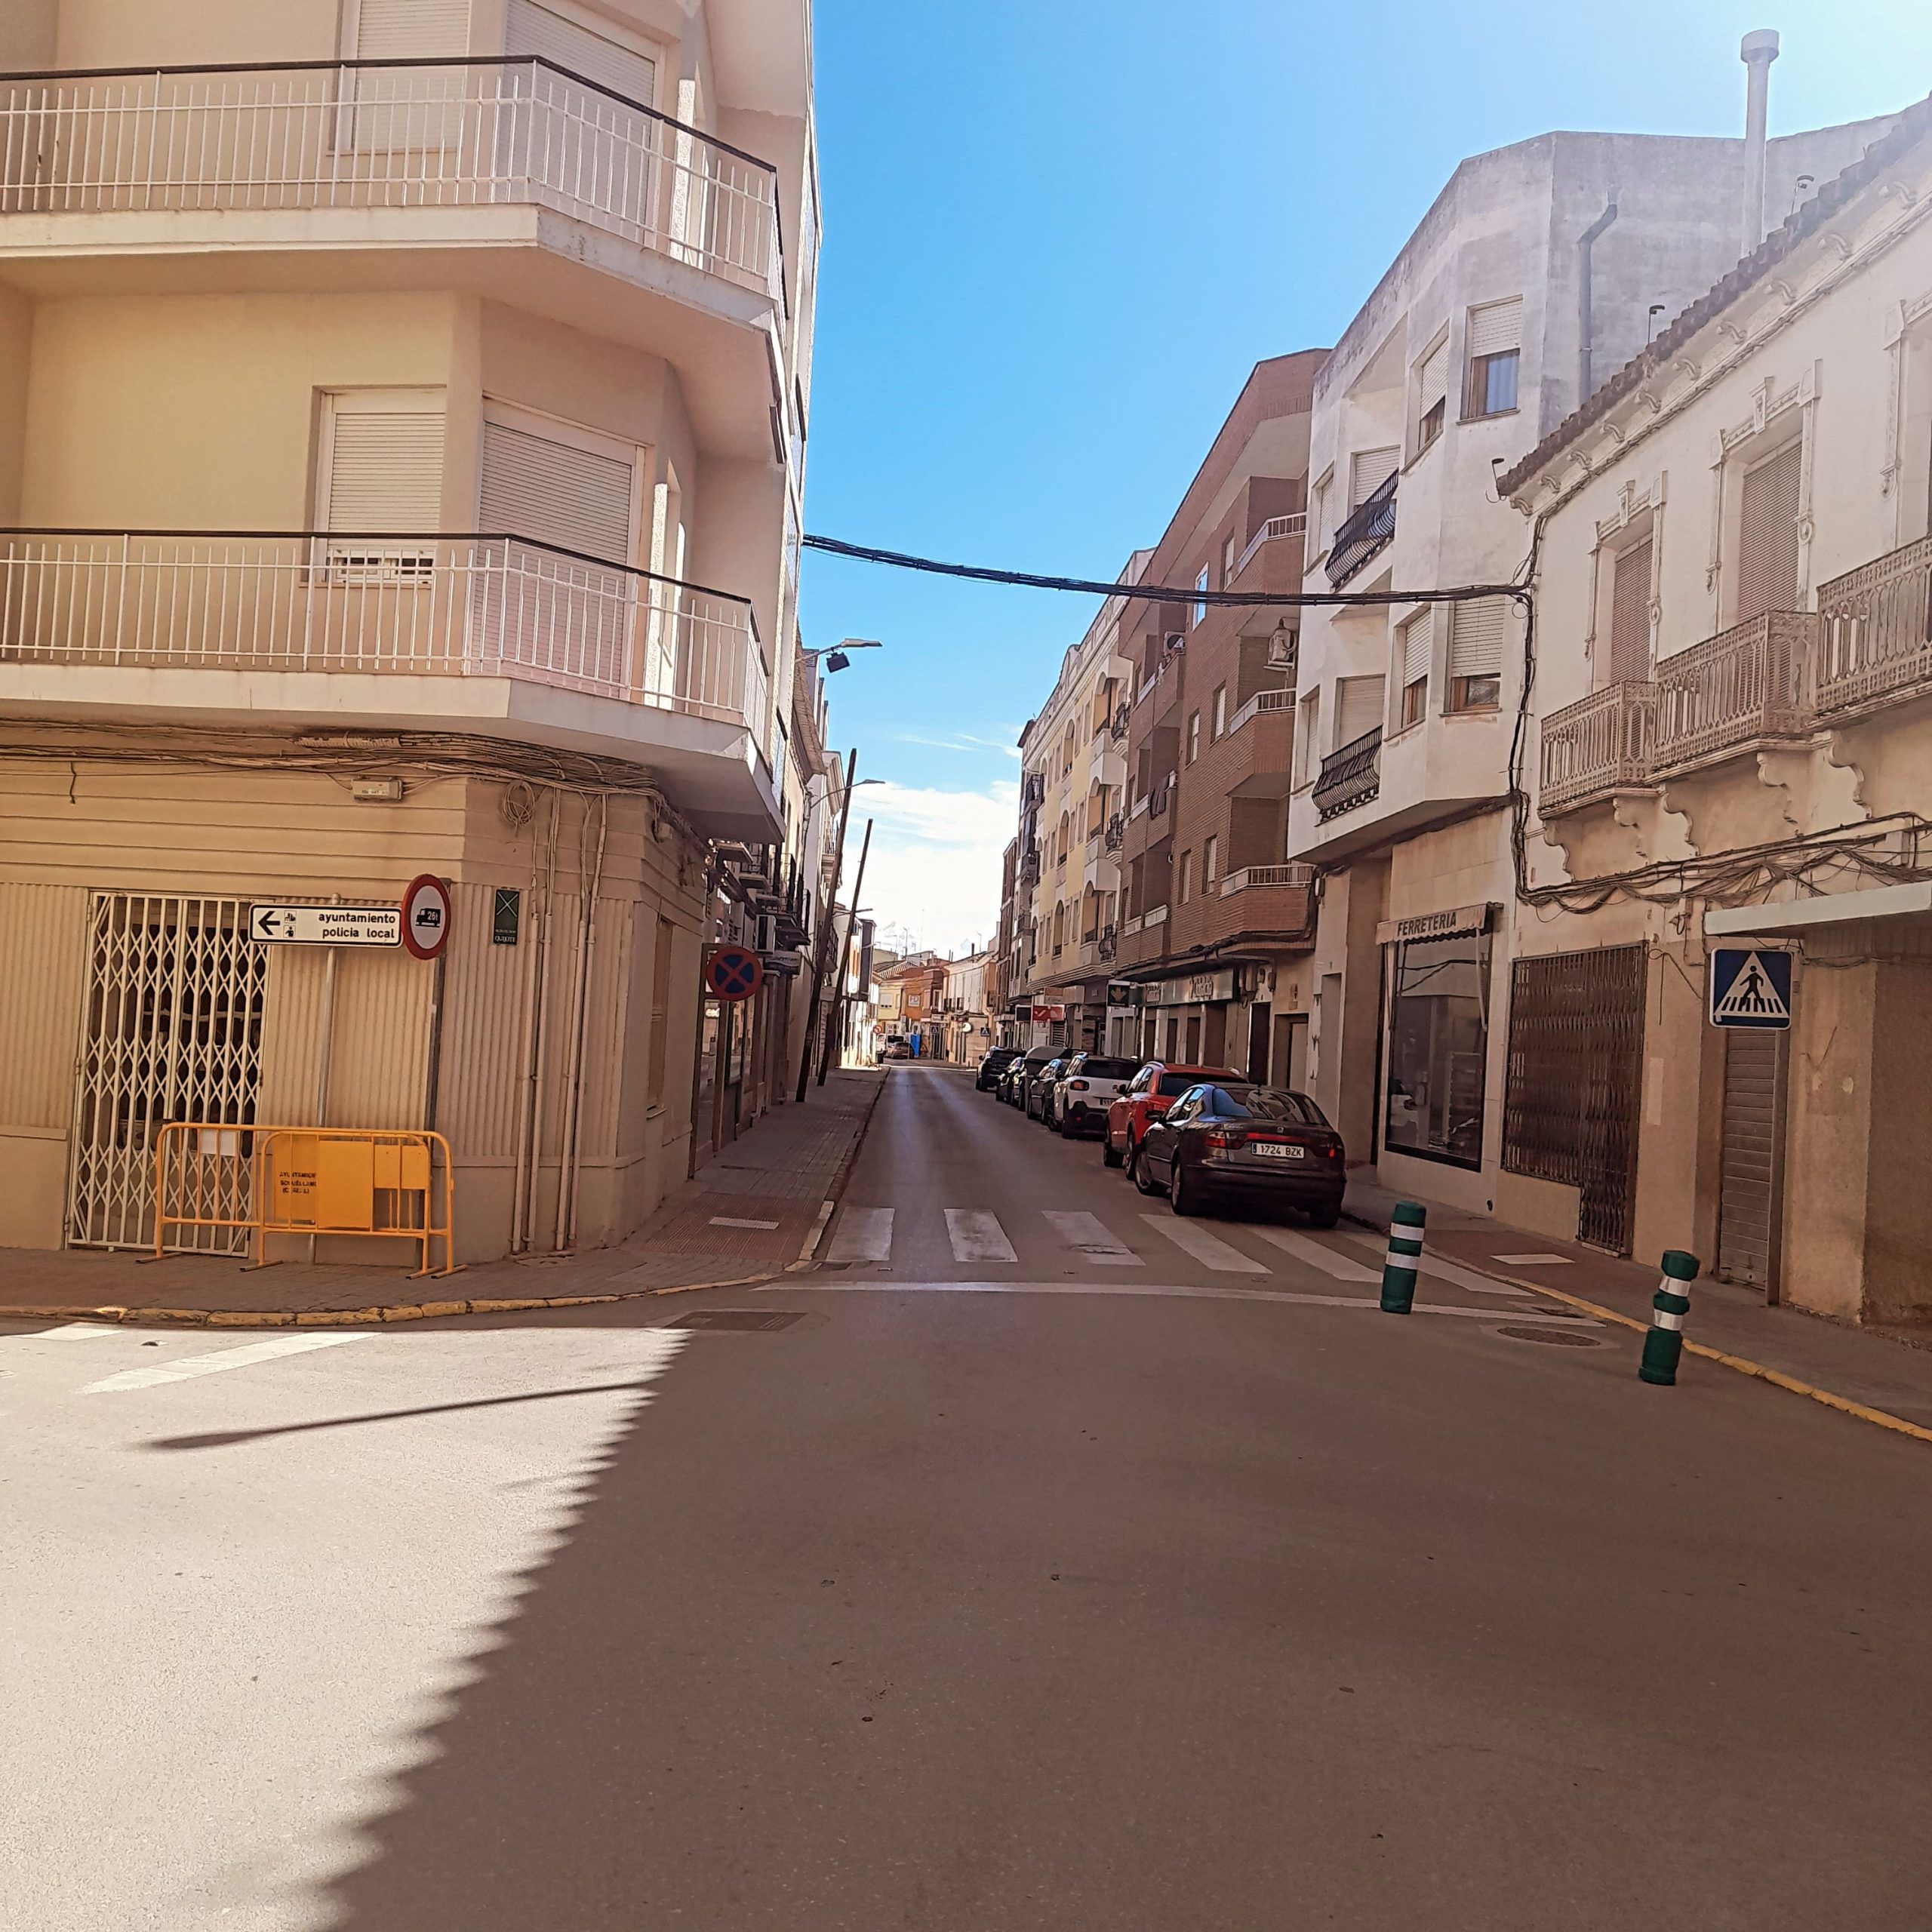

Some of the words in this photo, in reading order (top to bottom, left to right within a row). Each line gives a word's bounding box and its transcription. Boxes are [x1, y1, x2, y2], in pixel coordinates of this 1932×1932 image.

[318, 912, 395, 924] ayuntamiento
[427, 911, 438, 921] 26t
[1397, 912, 1457, 937] FERRETERIA
[322, 928, 359, 939] policia
[367, 928, 395, 938] local
[1260, 1145, 1281, 1155] 1724
[1285, 1146, 1302, 1156] BZK
